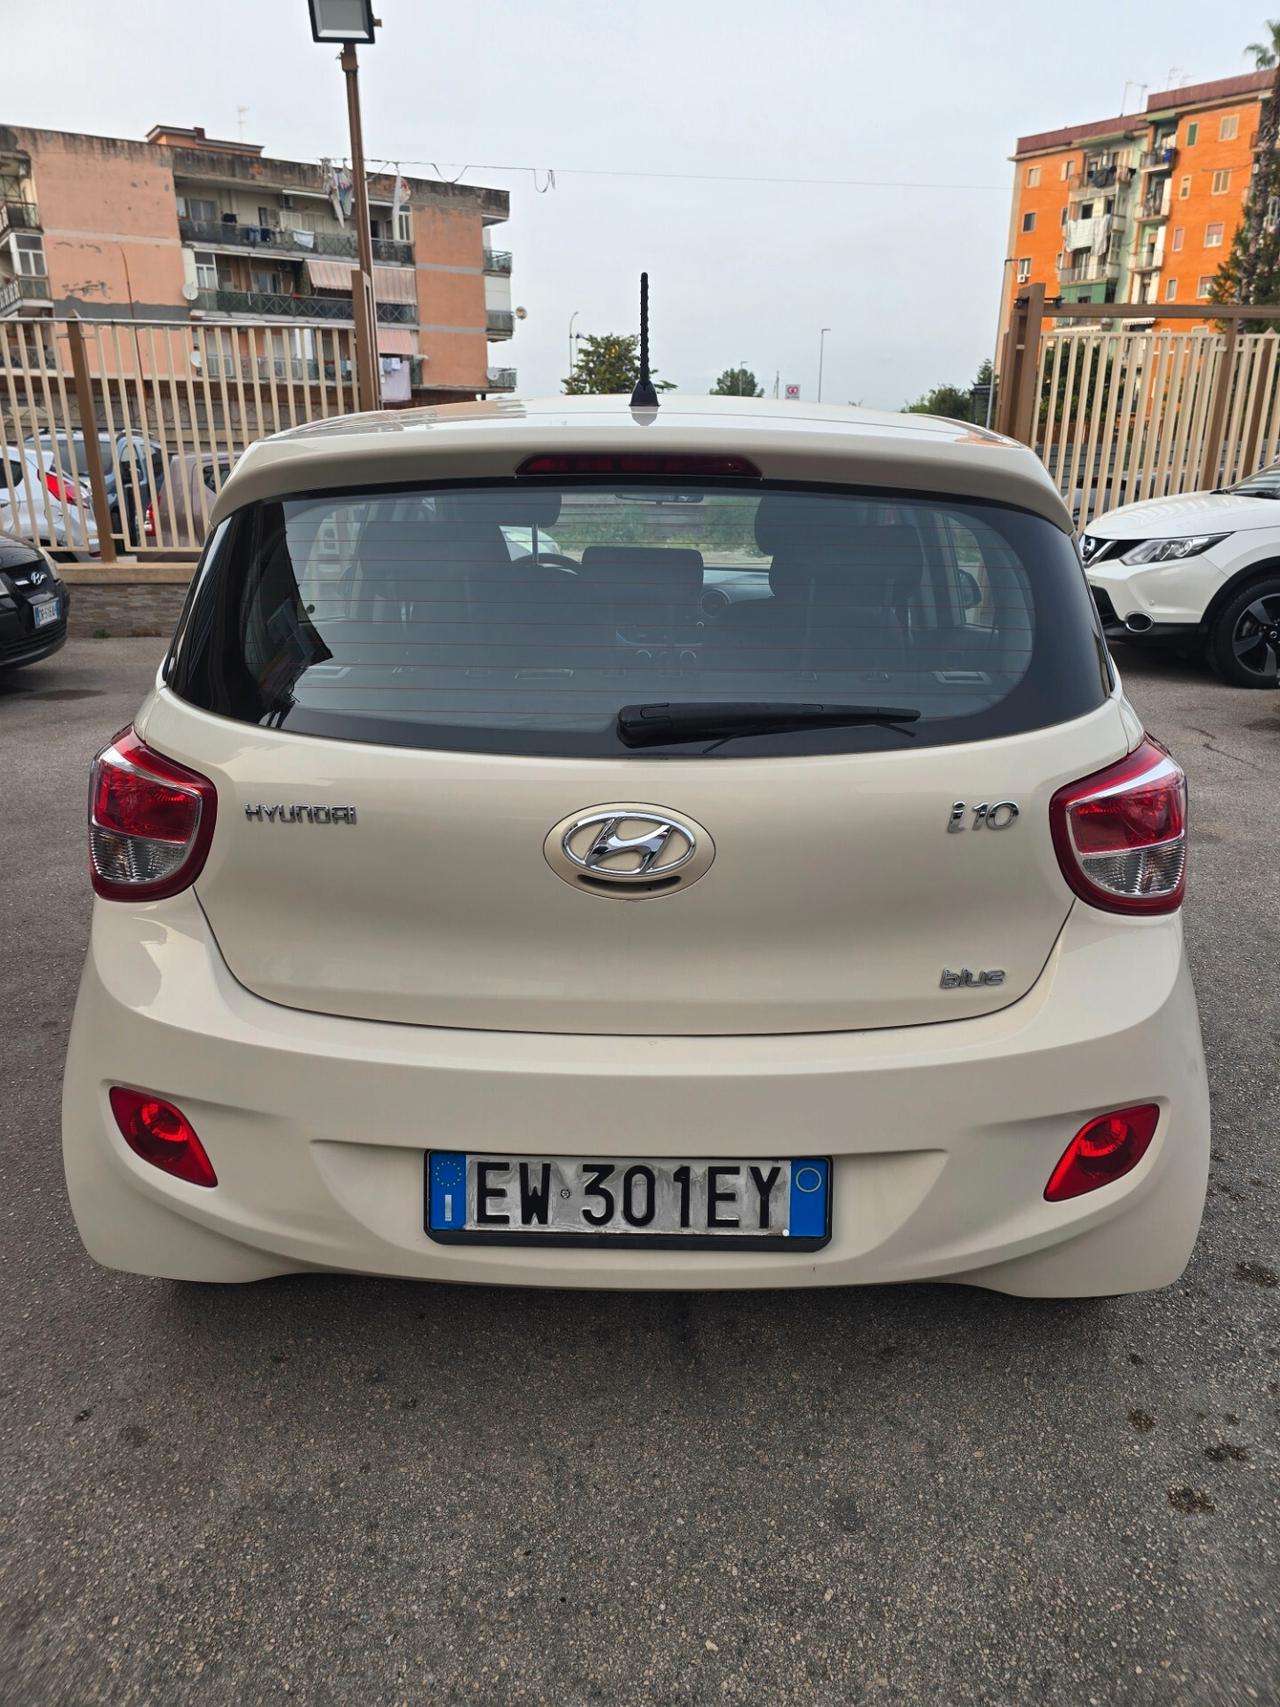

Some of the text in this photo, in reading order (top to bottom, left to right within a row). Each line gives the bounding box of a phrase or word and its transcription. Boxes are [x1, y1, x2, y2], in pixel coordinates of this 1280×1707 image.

[244, 803, 357, 825] HYUNDAI
[947, 800, 1020, 834] i10
[939, 968, 1006, 990] blue
[476, 1161, 782, 1229] EW 301EY
